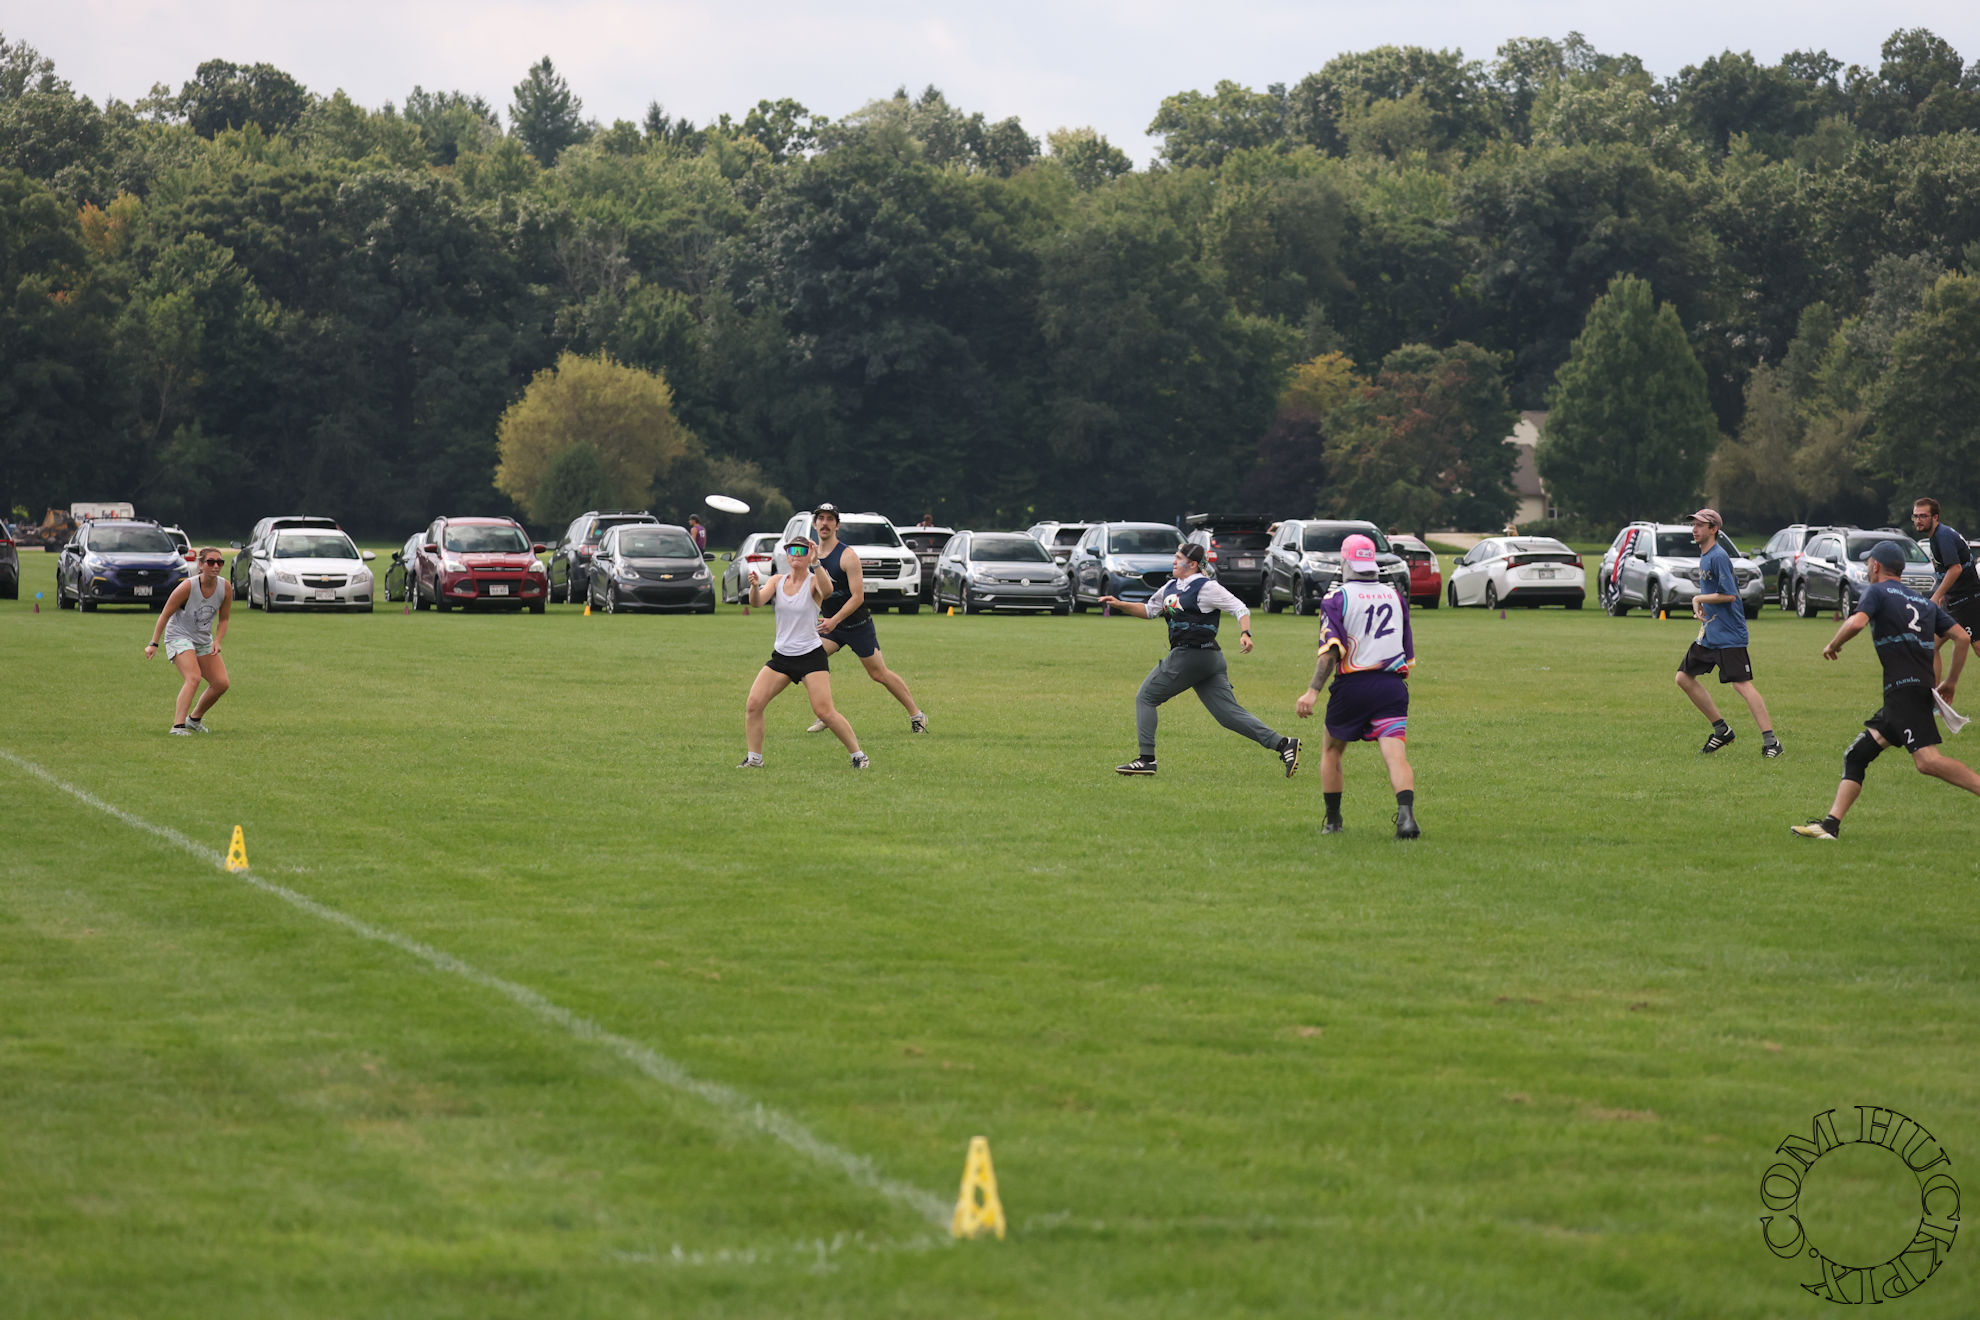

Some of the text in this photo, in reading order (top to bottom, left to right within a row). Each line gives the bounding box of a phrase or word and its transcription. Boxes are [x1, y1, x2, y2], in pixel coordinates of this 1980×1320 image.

[1358, 592, 1393, 600] Gerald
[1364, 603, 1396, 639] 12
[1905, 603, 1922, 632] 2
[1965, 626, 1973, 637] 3
[1903, 728, 1915, 745] 2
